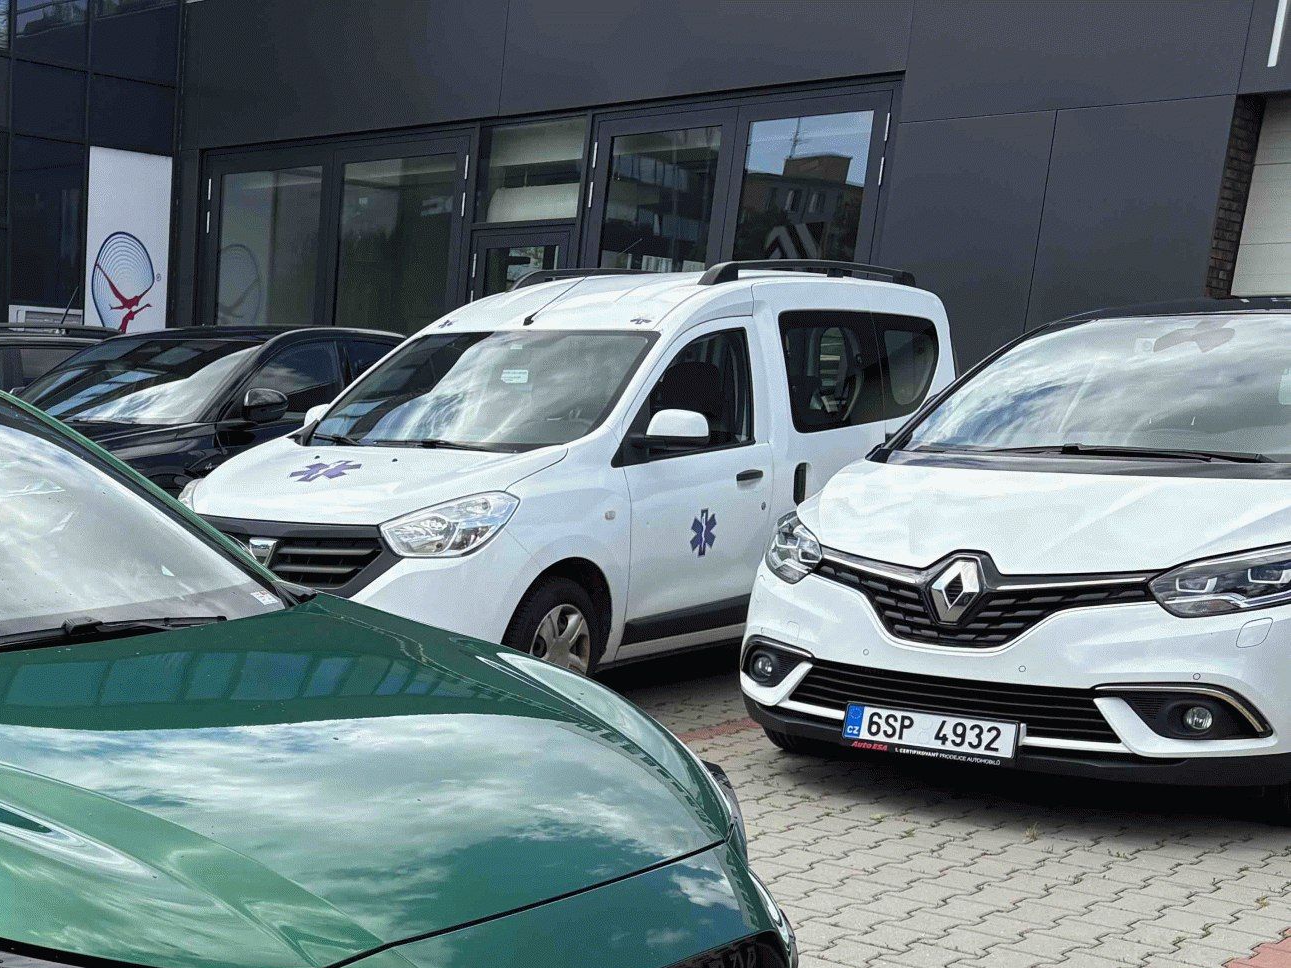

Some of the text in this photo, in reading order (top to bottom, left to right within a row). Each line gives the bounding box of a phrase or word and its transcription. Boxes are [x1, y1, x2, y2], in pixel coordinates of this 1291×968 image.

[847, 725, 860, 735] CZ
[867, 711, 1002, 752] 6SP 4932
